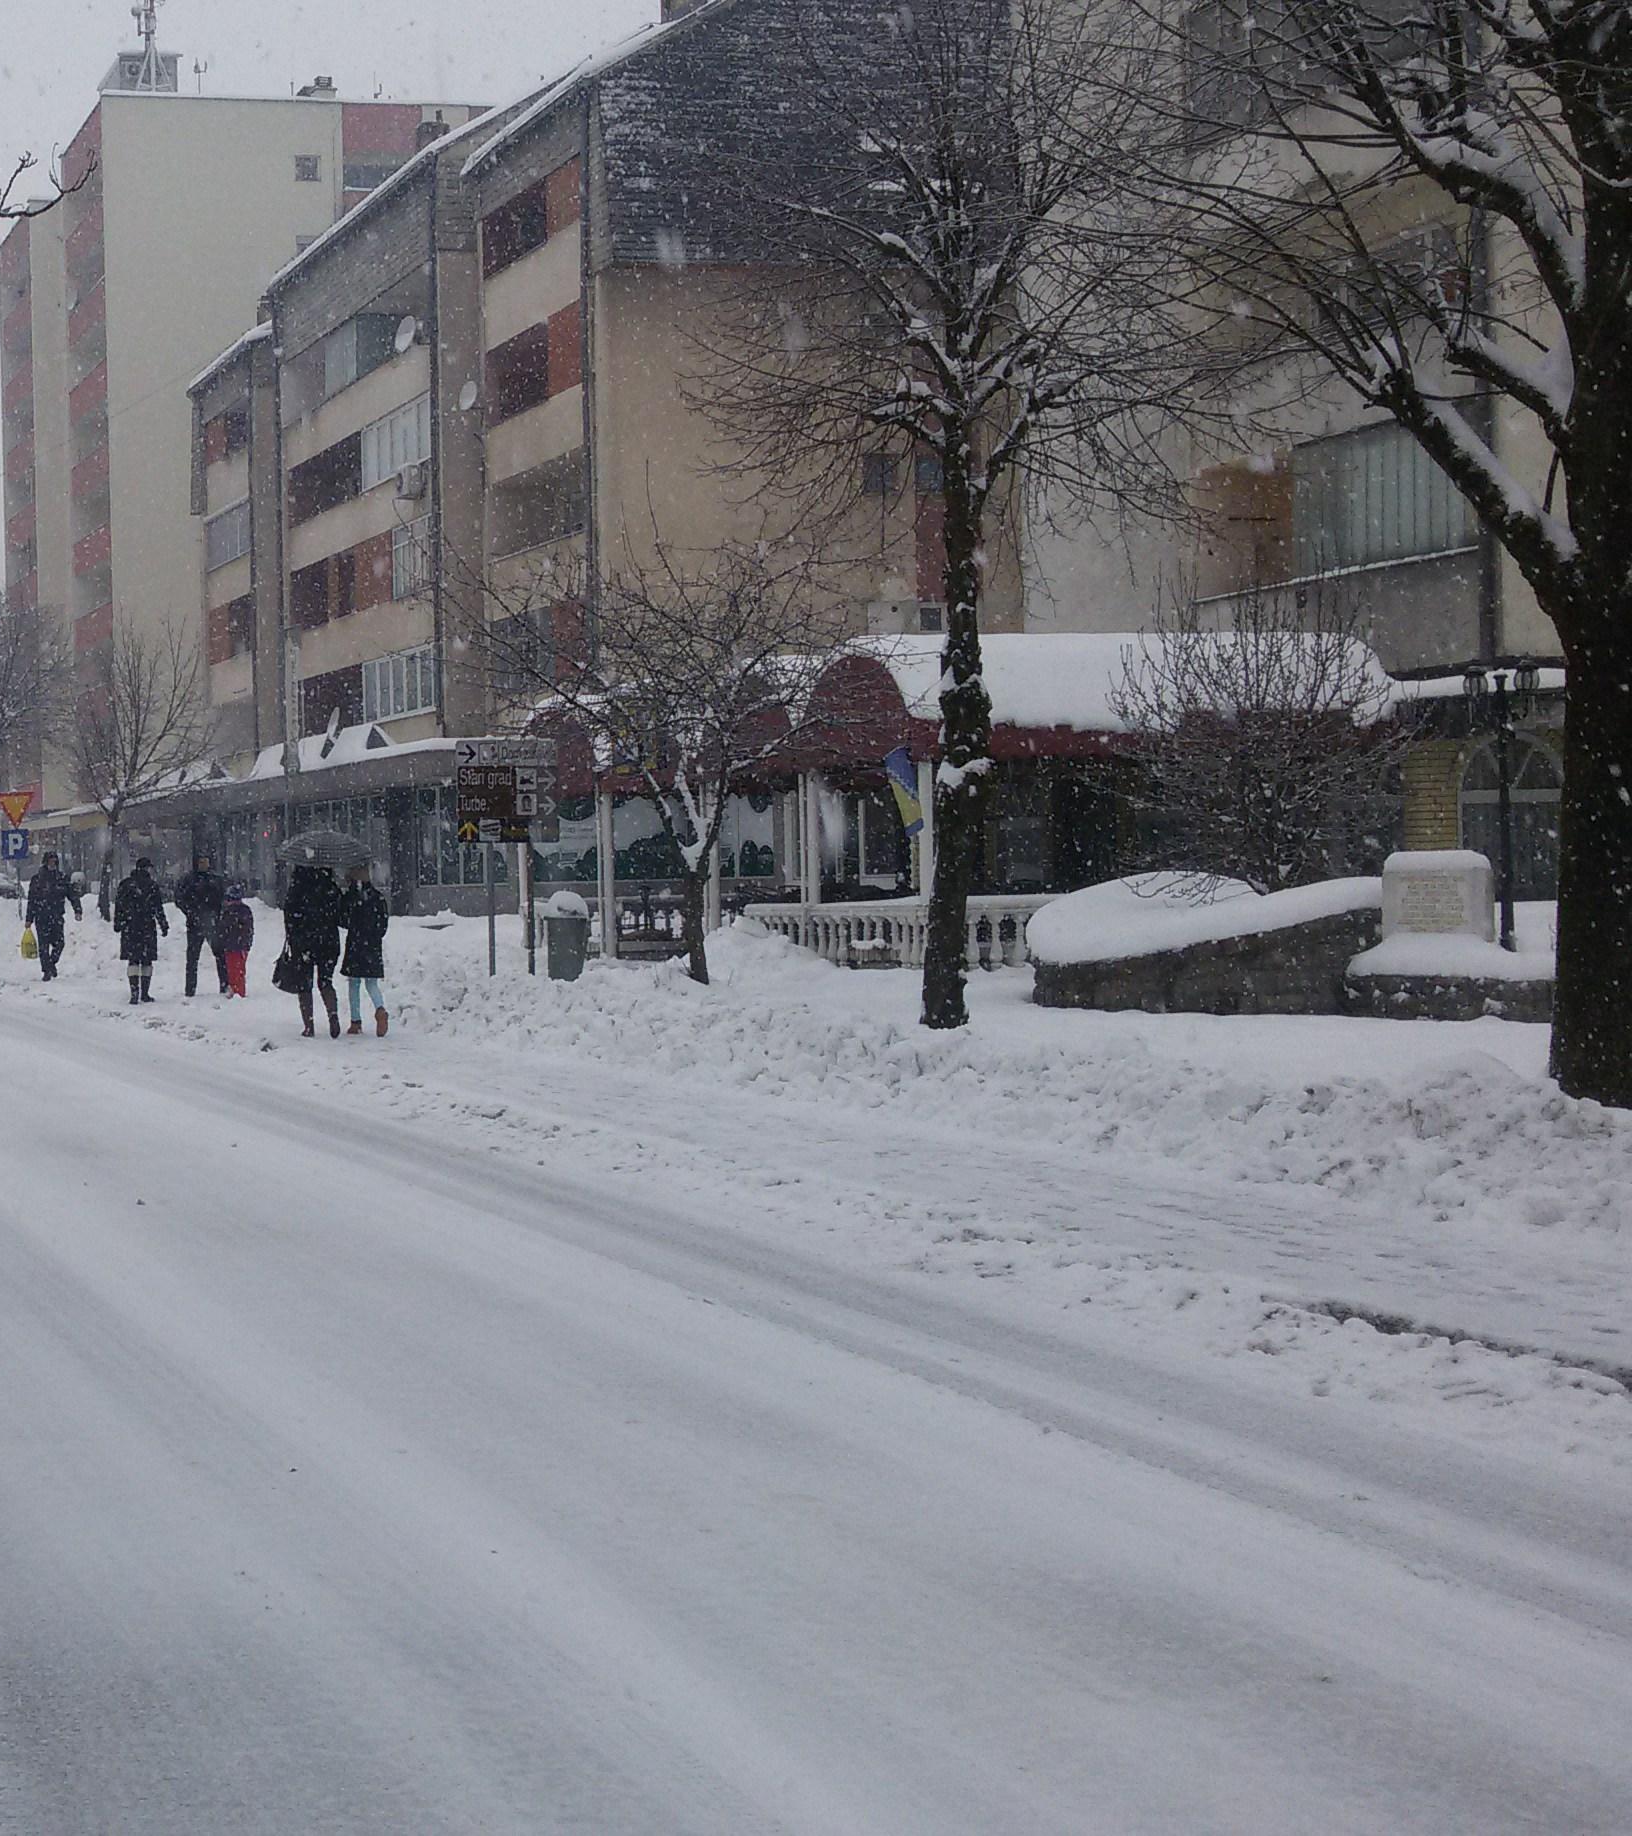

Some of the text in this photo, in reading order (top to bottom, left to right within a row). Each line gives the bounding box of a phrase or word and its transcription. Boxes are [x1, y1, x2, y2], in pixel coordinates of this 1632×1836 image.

[459, 768, 512, 789] Stari grad
[8, 833, 23, 856] P
